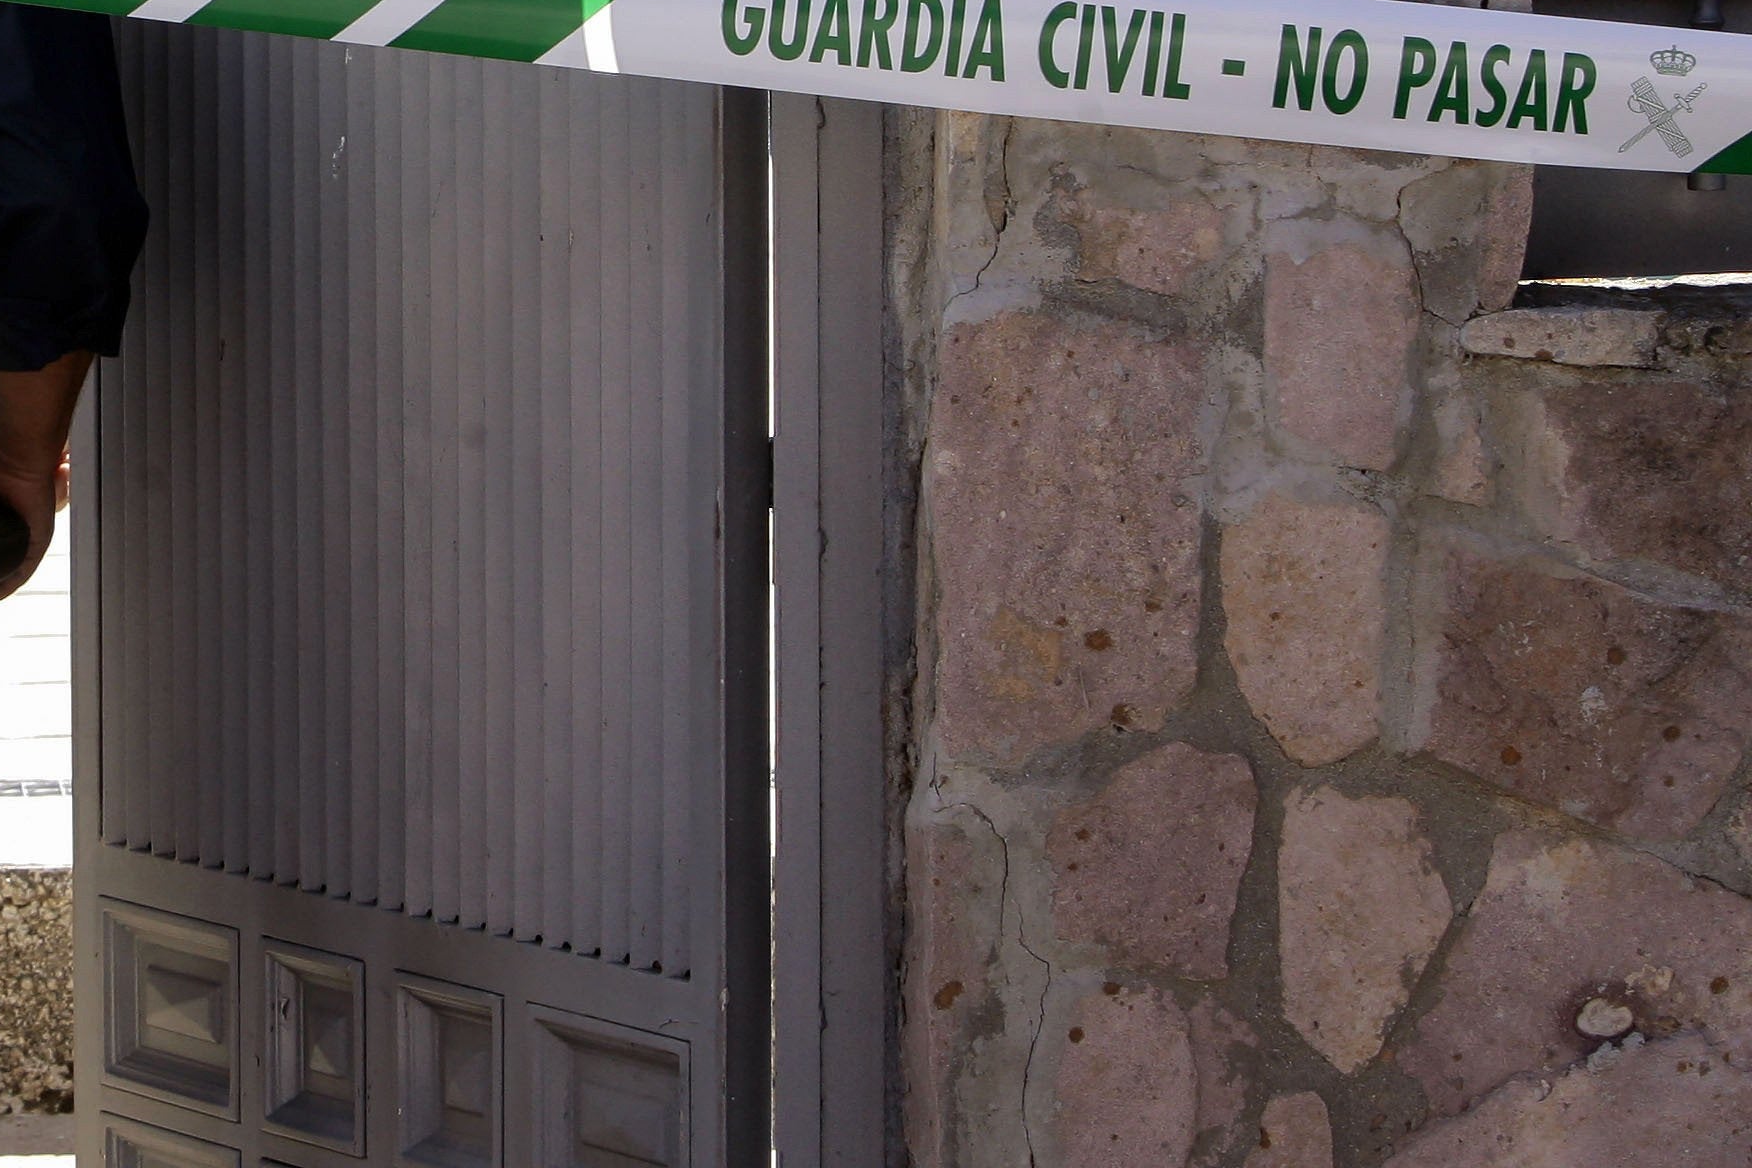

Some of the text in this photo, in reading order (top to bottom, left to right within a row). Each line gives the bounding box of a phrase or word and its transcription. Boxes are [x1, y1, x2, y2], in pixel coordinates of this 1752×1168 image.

[1038, 0, 1192, 100] CIVIL
[1271, 23, 1370, 116] NO
[1393, 35, 1598, 135] PASAR
